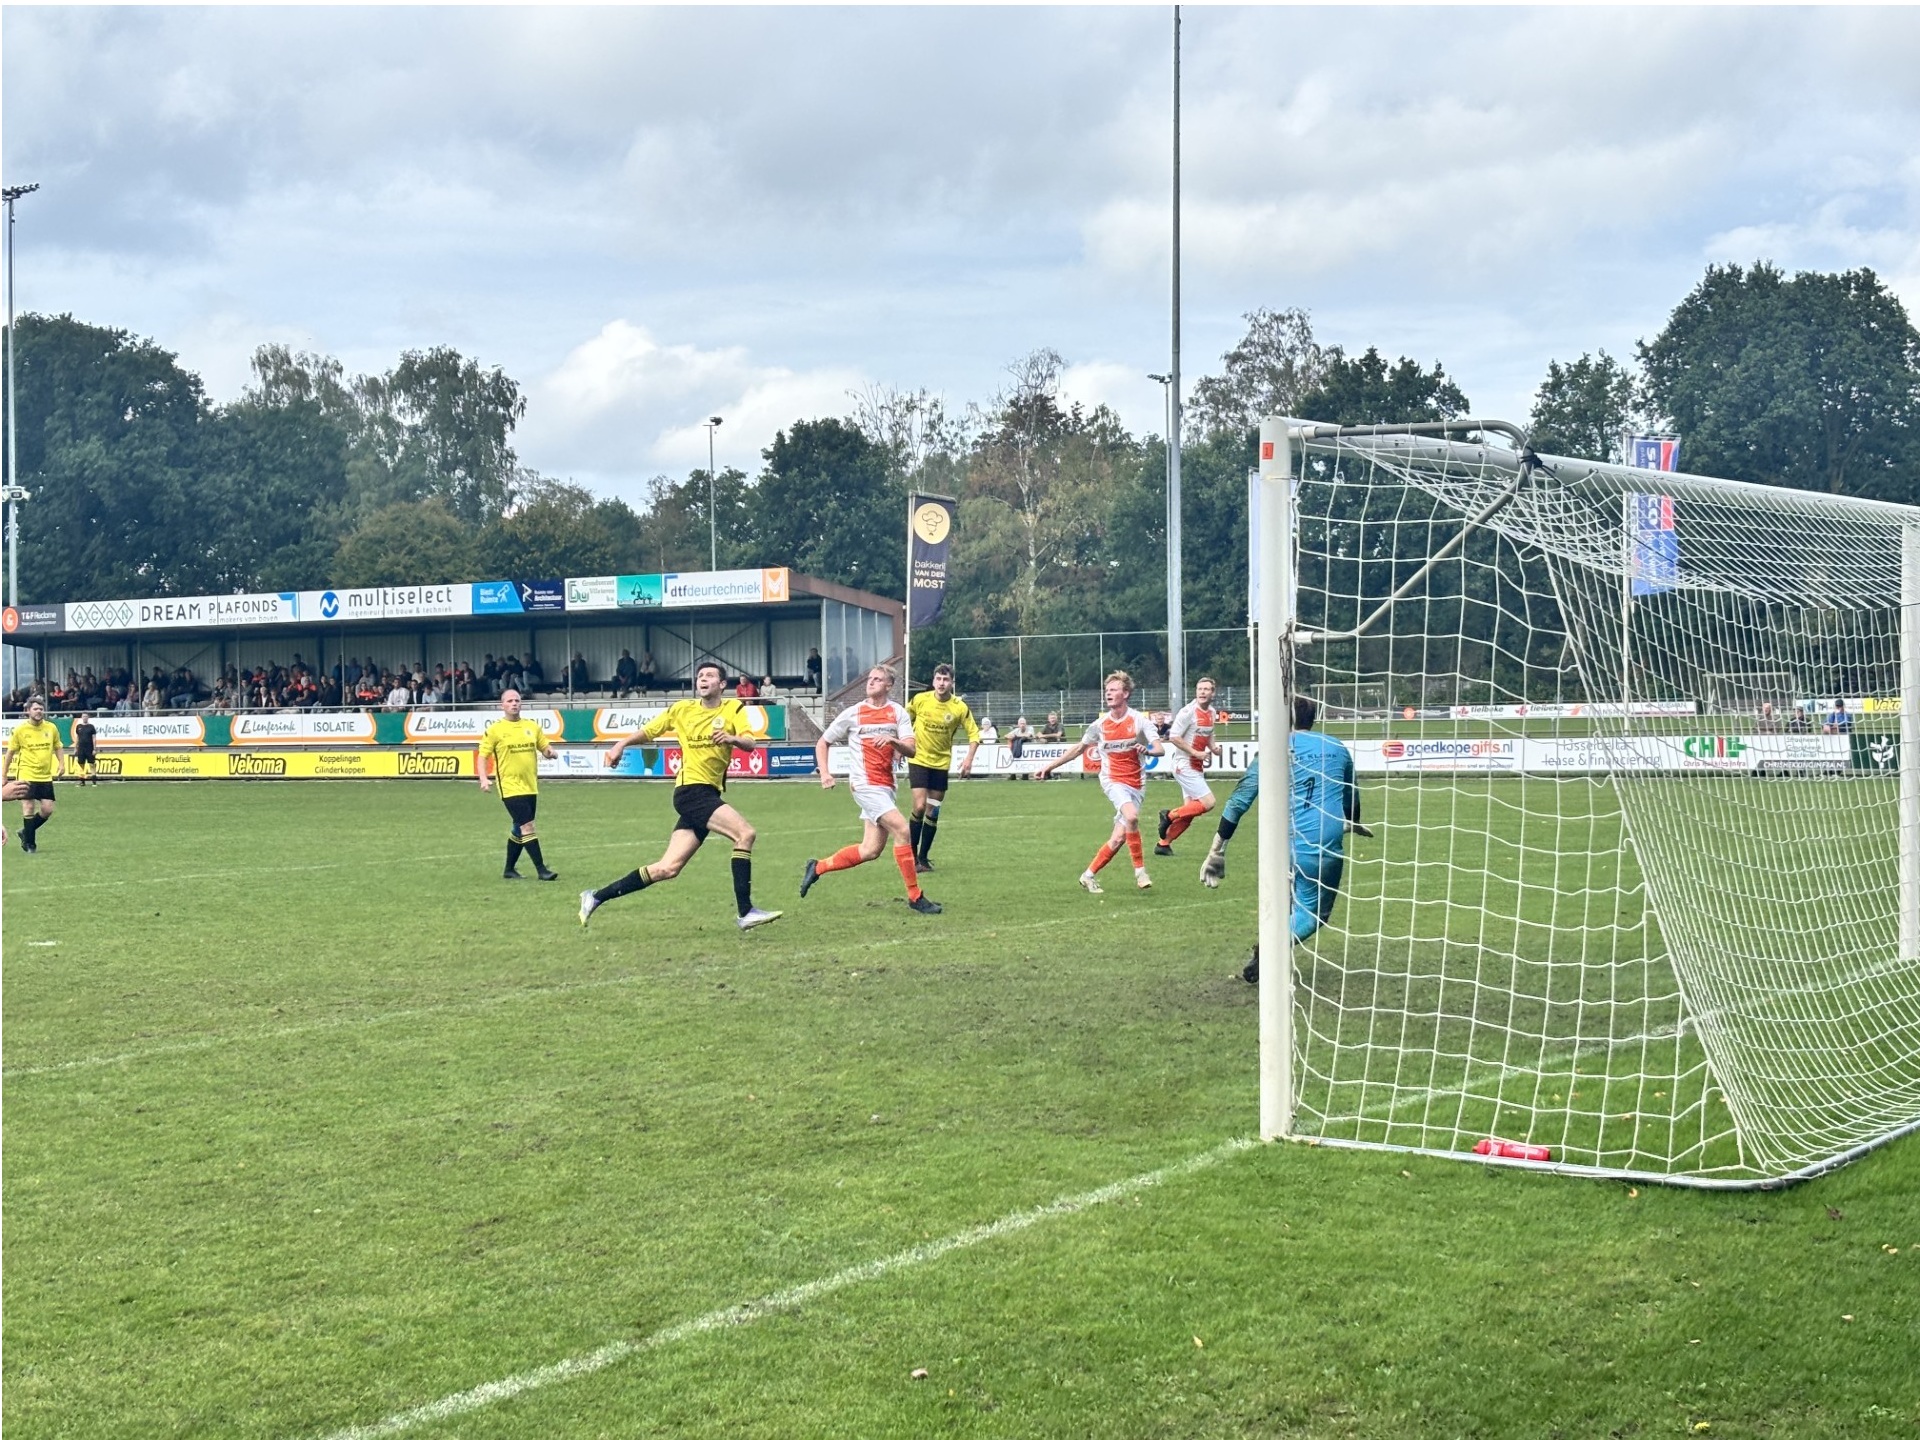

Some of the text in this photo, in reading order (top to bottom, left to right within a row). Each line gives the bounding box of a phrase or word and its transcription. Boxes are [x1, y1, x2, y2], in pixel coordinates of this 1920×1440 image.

[915, 560, 946, 572] bakkerij
[915, 569, 945, 578] VAN DER
[670, 582, 761, 598] dtfdeurtechniek
[913, 578, 945, 589] MOST
[348, 586, 453, 607] multiselect
[141, 600, 278, 622] DREAM PLAFONDS
[348, 609, 385, 618] ingenieurs
[422, 606, 453, 614] techniek
[1873, 698, 1901, 711] Veko
[95, 722, 190, 737] enferink RENOVATIE
[252, 721, 355, 735] Lenferink ISOLATIE
[428, 717, 476, 733] Lenferink
[1407, 740, 1513, 756] goedkopegifts.nl
[1563, 739, 1628, 751] IJsseldelta
[229, 754, 286, 775] Vekoma
[319, 755, 361, 764] Koppelingen
[398, 753, 459, 774] Vekoma
[1545, 752, 1660, 767] lease & financiering
[314, 766, 366, 775] Cilinderkoppen
